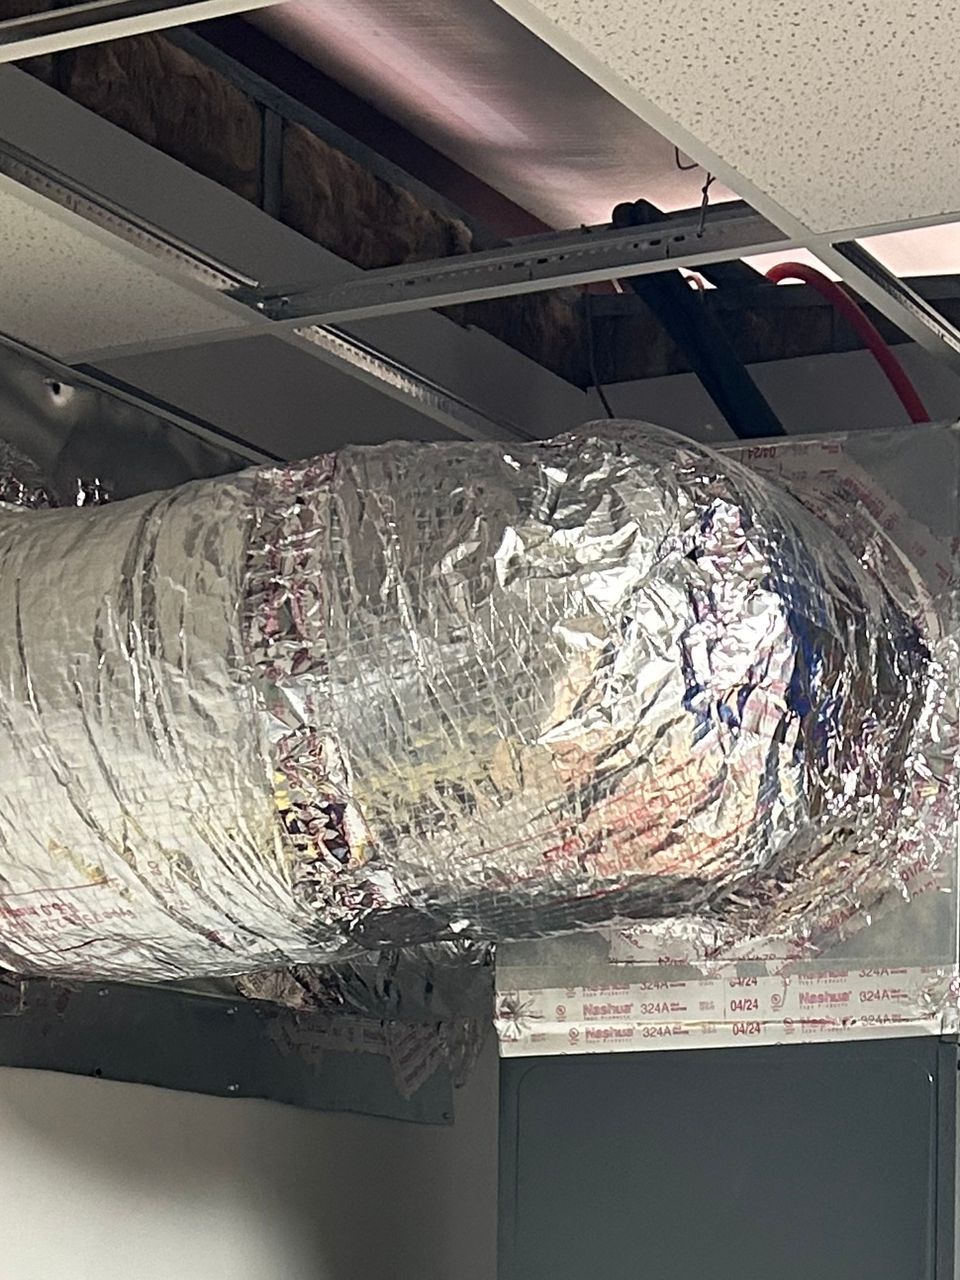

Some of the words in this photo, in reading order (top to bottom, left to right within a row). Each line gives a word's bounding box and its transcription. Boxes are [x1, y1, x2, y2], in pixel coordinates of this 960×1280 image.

[640, 1002, 670, 1014] 324A
[730, 999, 759, 1012] 04/24
[860, 988, 890, 1002] 324A
[642, 1026, 672, 1038] 324A
[732, 1022, 761, 1035] 04/24
